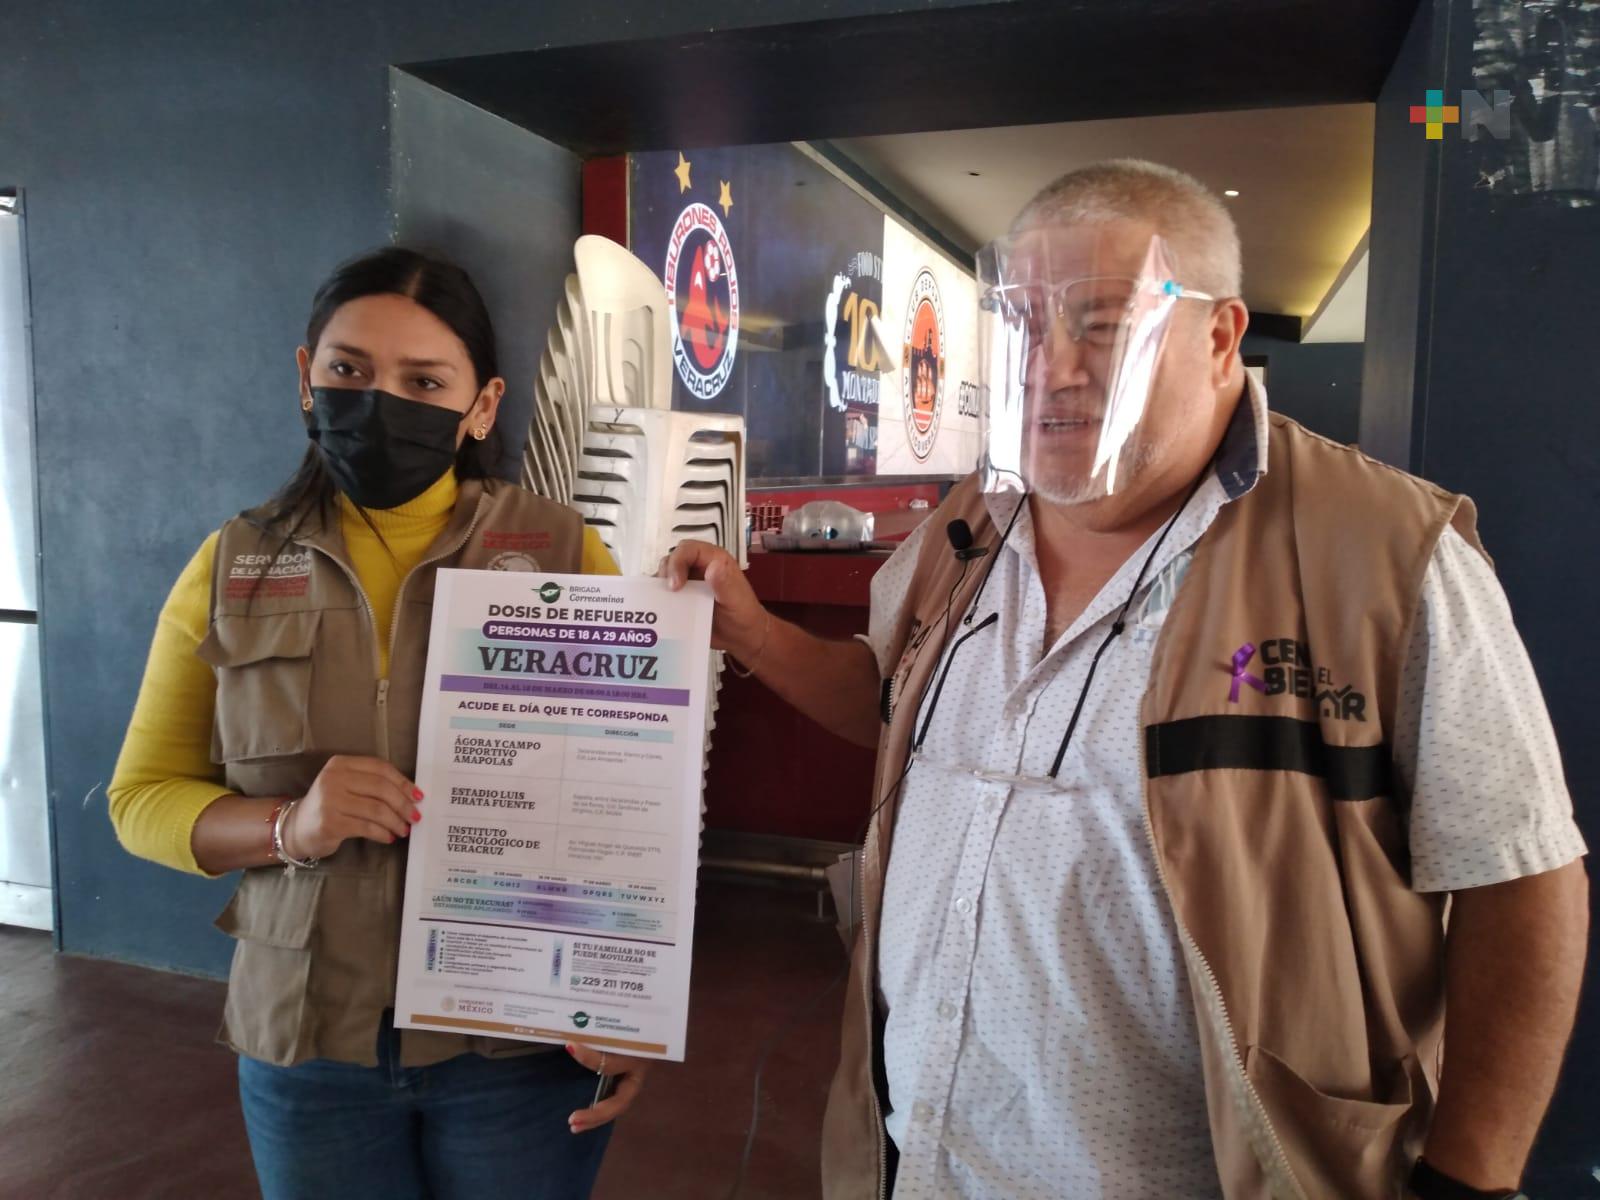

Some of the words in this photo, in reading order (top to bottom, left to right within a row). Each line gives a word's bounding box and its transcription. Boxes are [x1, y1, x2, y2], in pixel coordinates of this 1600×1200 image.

[674, 336, 732, 396] VERACRUZ
[569, 593, 624, 604] Correcaminos
[488, 604, 541, 619] DOSIS
[546, 607, 569, 620] DE
[573, 609, 658, 625] REFUERZO
[488, 624, 556, 639] PERSONAS
[558, 629, 575, 640] DE
[578, 630, 589, 640] 18
[592, 630, 600, 641] A
[603, 631, 616, 642] 29
[619, 630, 652, 644] AÑOS
[478, 646, 658, 681] VERACRUZ
[458, 701, 499, 711] ACUDE
[502, 704, 516, 712] EL
[519, 703, 540, 713] DÍA
[543, 706, 568, 716] QUE
[571, 708, 584, 716] TE
[586, 709, 669, 722] CORRESPONDA
[455, 735, 492, 747] ÁGORA
[494, 740, 501, 748] Y
[502, 741, 541, 750] CAMPO
[454, 746, 517, 757] DEPORTIVO
[453, 756, 514, 767] AMAPOLAS
[451, 788, 498, 798] ESTADIO
[500, 791, 525, 800] LUIS
[451, 797, 490, 807] PIRATA
[493, 800, 536, 810] FUENTE
[448, 825, 507, 838] INSTITUTO
[447, 844, 504, 856] VERACRUZ
[526, 841, 541, 849] DE
[582, 976, 601, 986] 229
[603, 979, 617, 988] 211
[620, 981, 644, 991] 1708
[458, 1004, 493, 1014] MÉXICO
